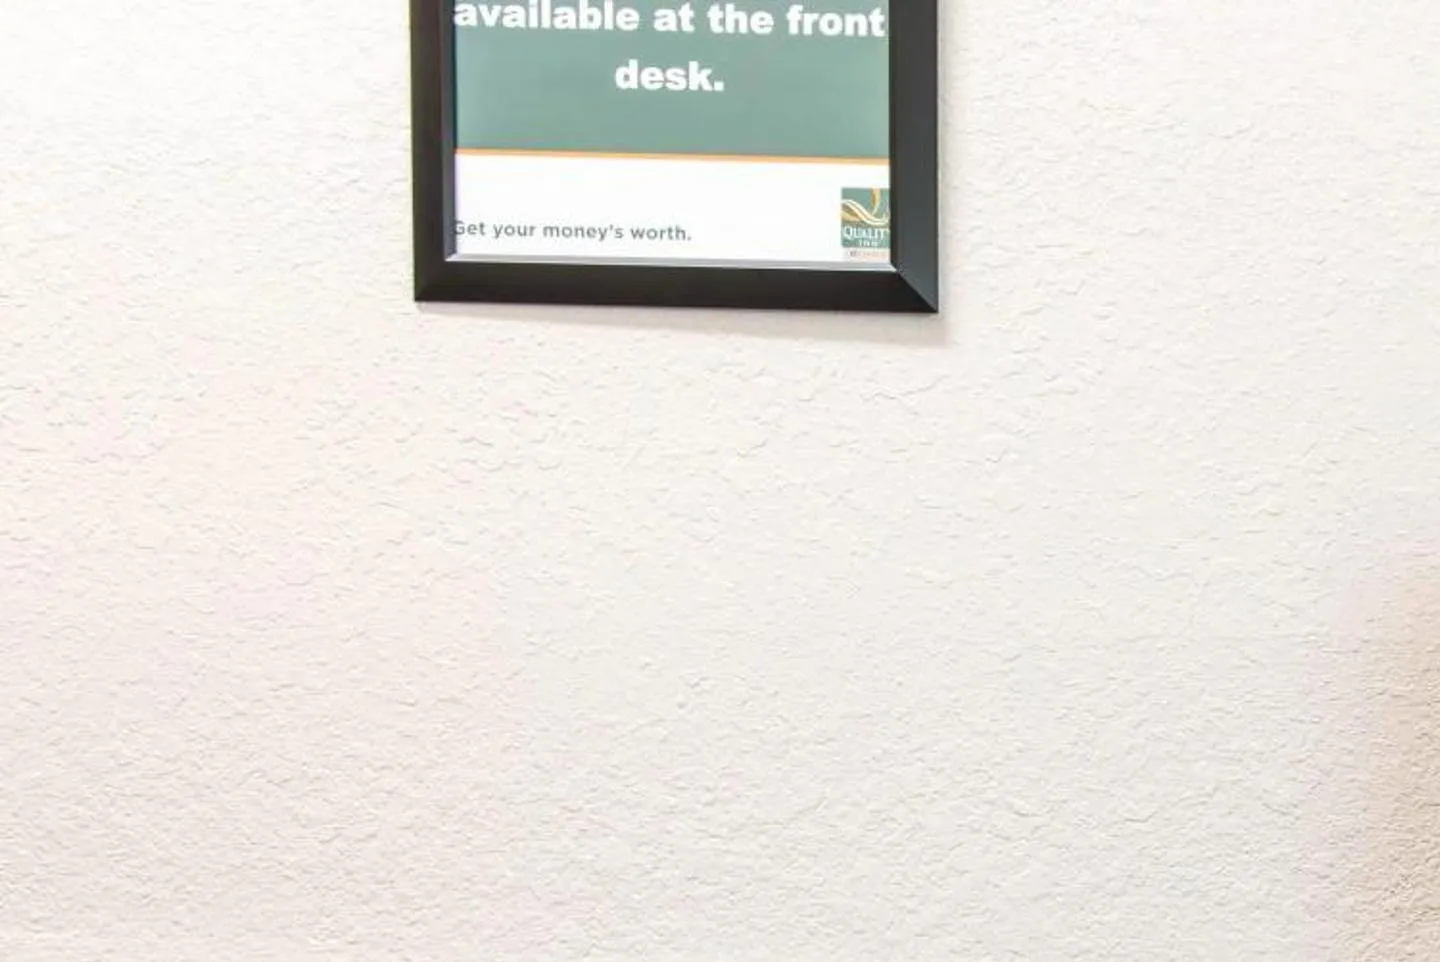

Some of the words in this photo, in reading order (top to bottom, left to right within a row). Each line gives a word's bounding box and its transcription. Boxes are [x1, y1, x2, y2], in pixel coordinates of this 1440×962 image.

[454, 0, 640, 31] available
[653, 2, 695, 32] at
[707, 3, 774, 34] the
[786, 5, 886, 37] front
[614, 58, 725, 91] desk.
[492, 222, 536, 239] your
[542, 222, 625, 242] money's
[630, 225, 692, 241] worth.
